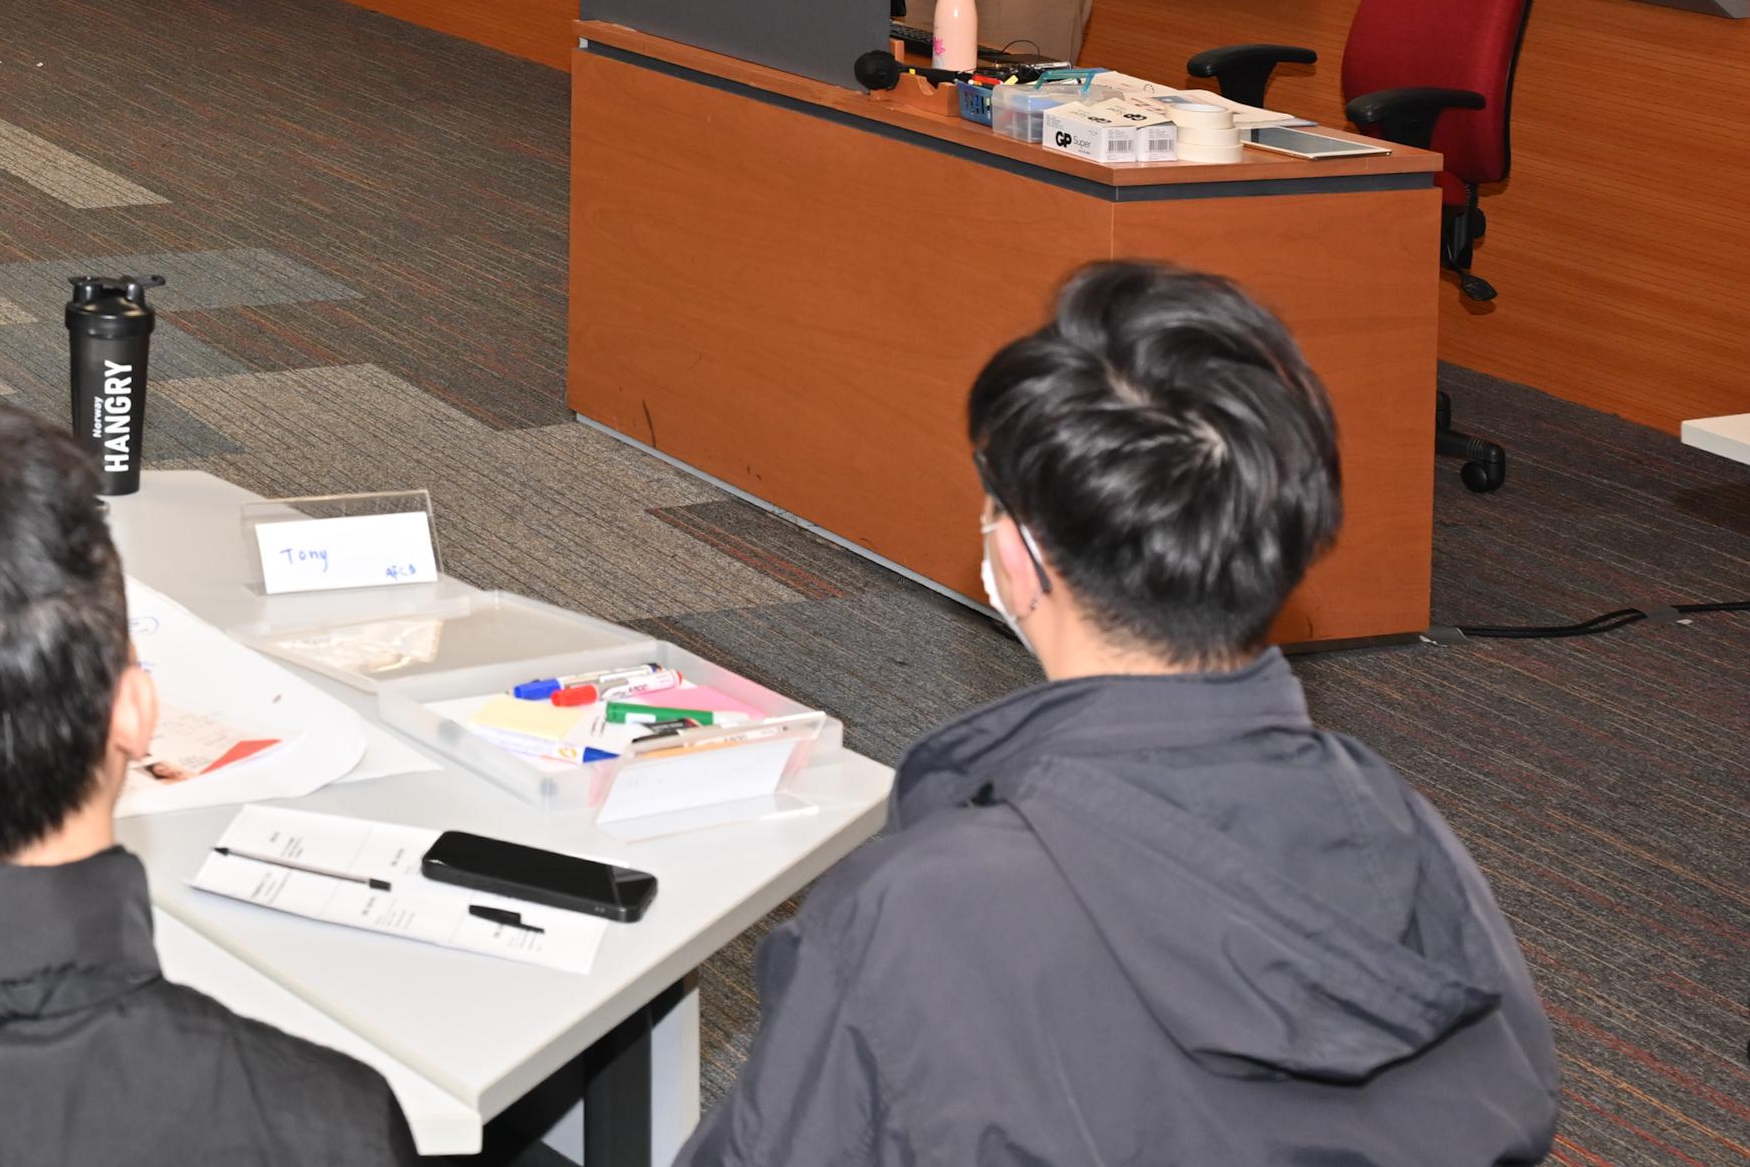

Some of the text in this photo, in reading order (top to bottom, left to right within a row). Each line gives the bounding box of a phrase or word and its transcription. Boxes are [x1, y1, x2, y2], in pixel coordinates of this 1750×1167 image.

[1055, 130, 1091, 148] GP Super
[92, 395, 104, 439] Norway
[103, 359, 133, 472] HANGRY
[279, 547, 329, 574] Tony
